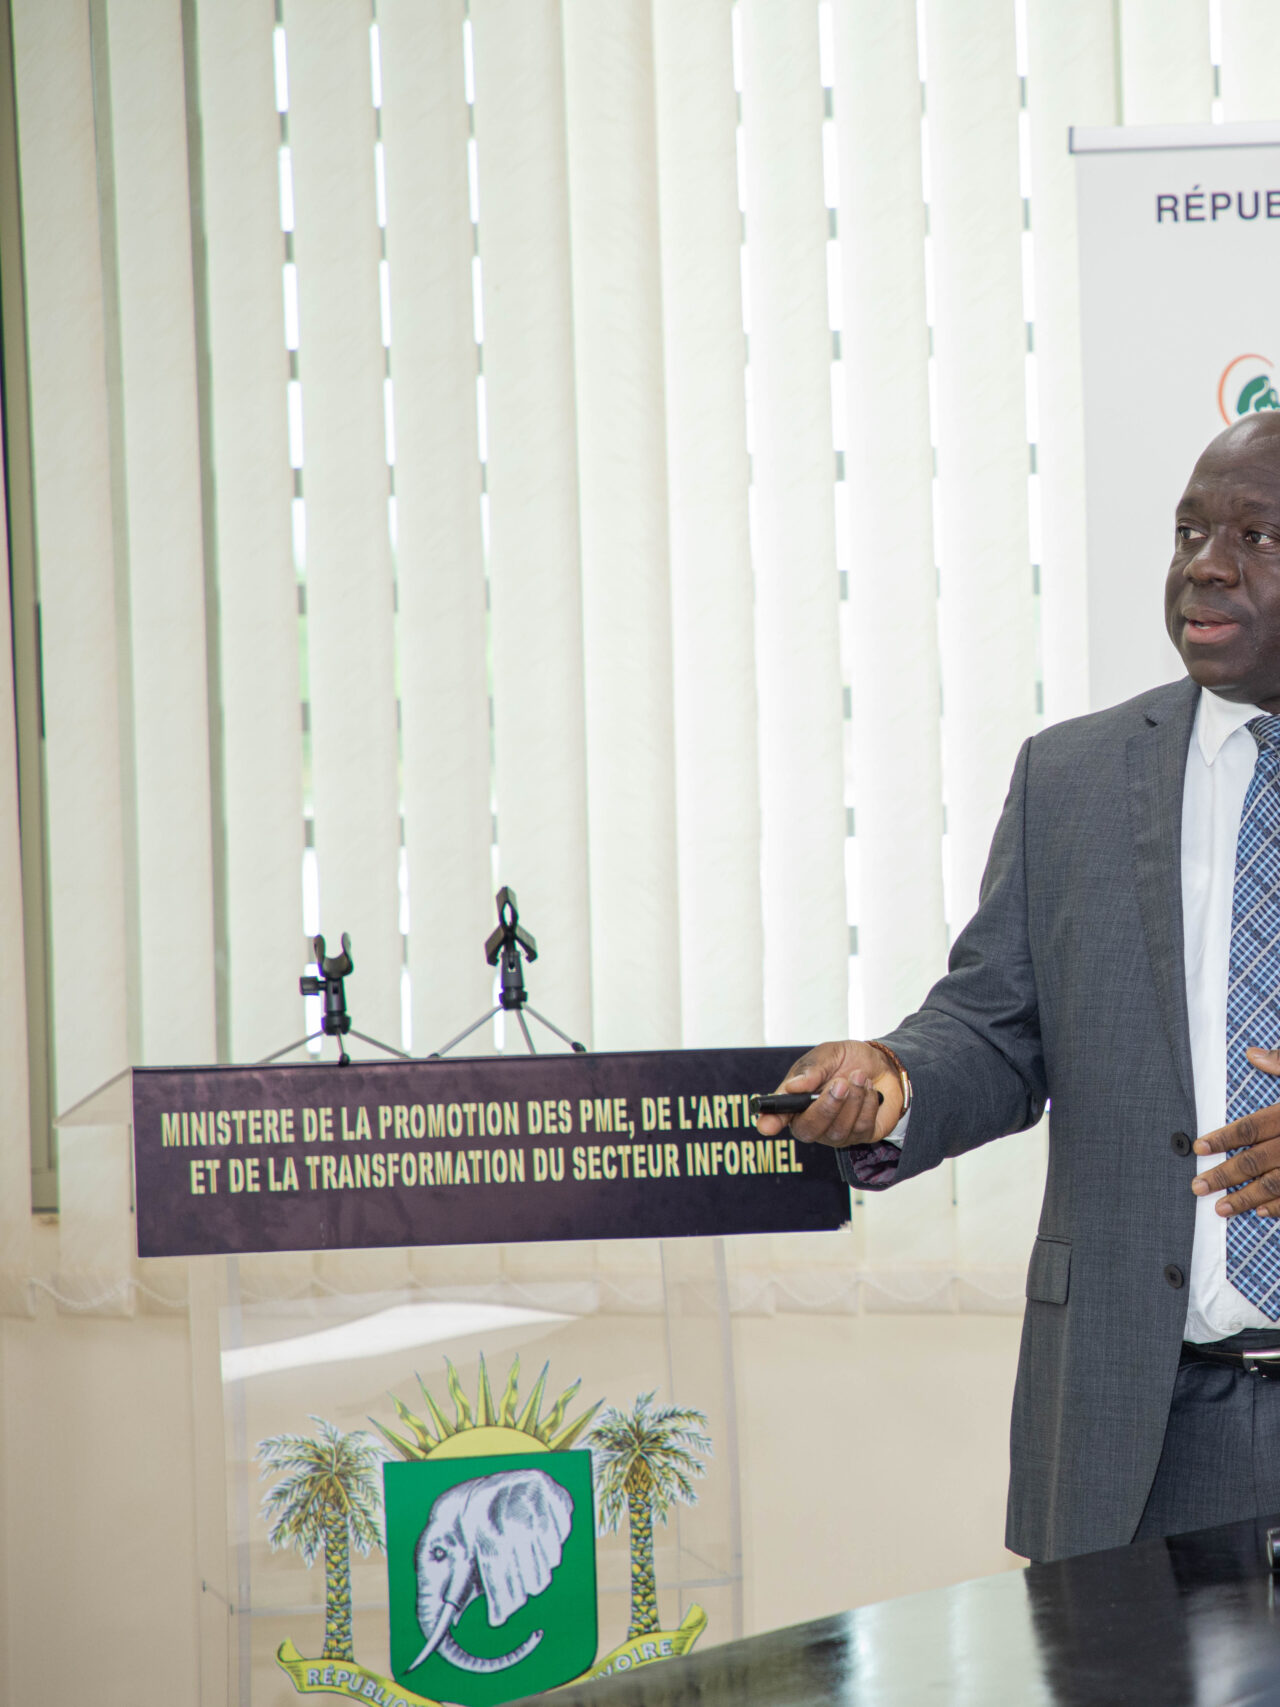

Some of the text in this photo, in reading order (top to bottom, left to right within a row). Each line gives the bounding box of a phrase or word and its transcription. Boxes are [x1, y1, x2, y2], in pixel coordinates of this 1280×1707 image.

[161, 1108, 295, 1148] MINISTERE
[302, 1107, 335, 1142] DE
[341, 1105, 373, 1141] LA
[378, 1101, 520, 1140] PROMOTION
[527, 1099, 573, 1136] DES
[579, 1097, 636, 1140] PME,
[641, 1096, 672, 1131] DE
[190, 1138, 803, 1195] ET DE LA TRANSFORMATION DU SECTEUR INFORMEL
